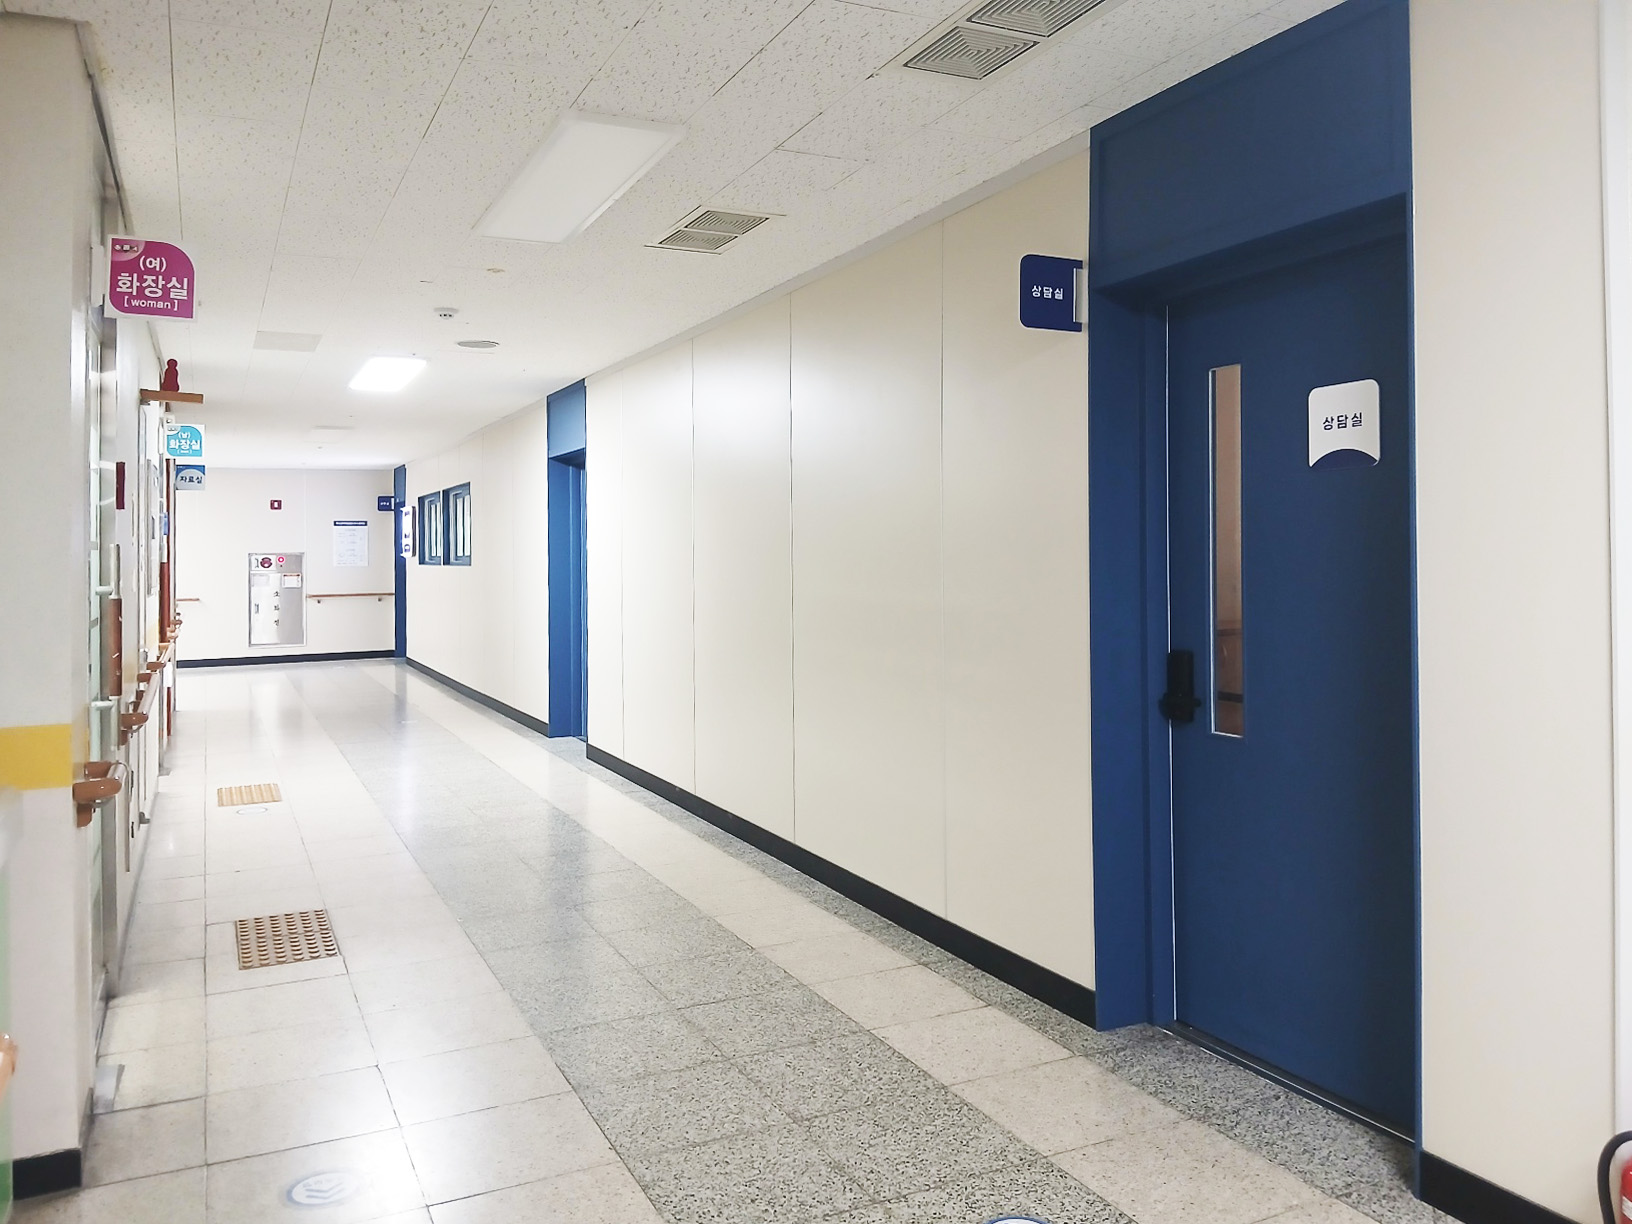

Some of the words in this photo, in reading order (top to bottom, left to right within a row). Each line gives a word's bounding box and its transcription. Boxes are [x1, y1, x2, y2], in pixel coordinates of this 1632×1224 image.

[139, 255, 167, 272] (여)
[116, 272, 189, 300] 화장실
[1031, 285, 1064, 300] 상담실
[1322, 412, 1363, 431] 상담실
[169, 439, 201, 451] 화장실
[179, 475, 203, 484] 자료실
